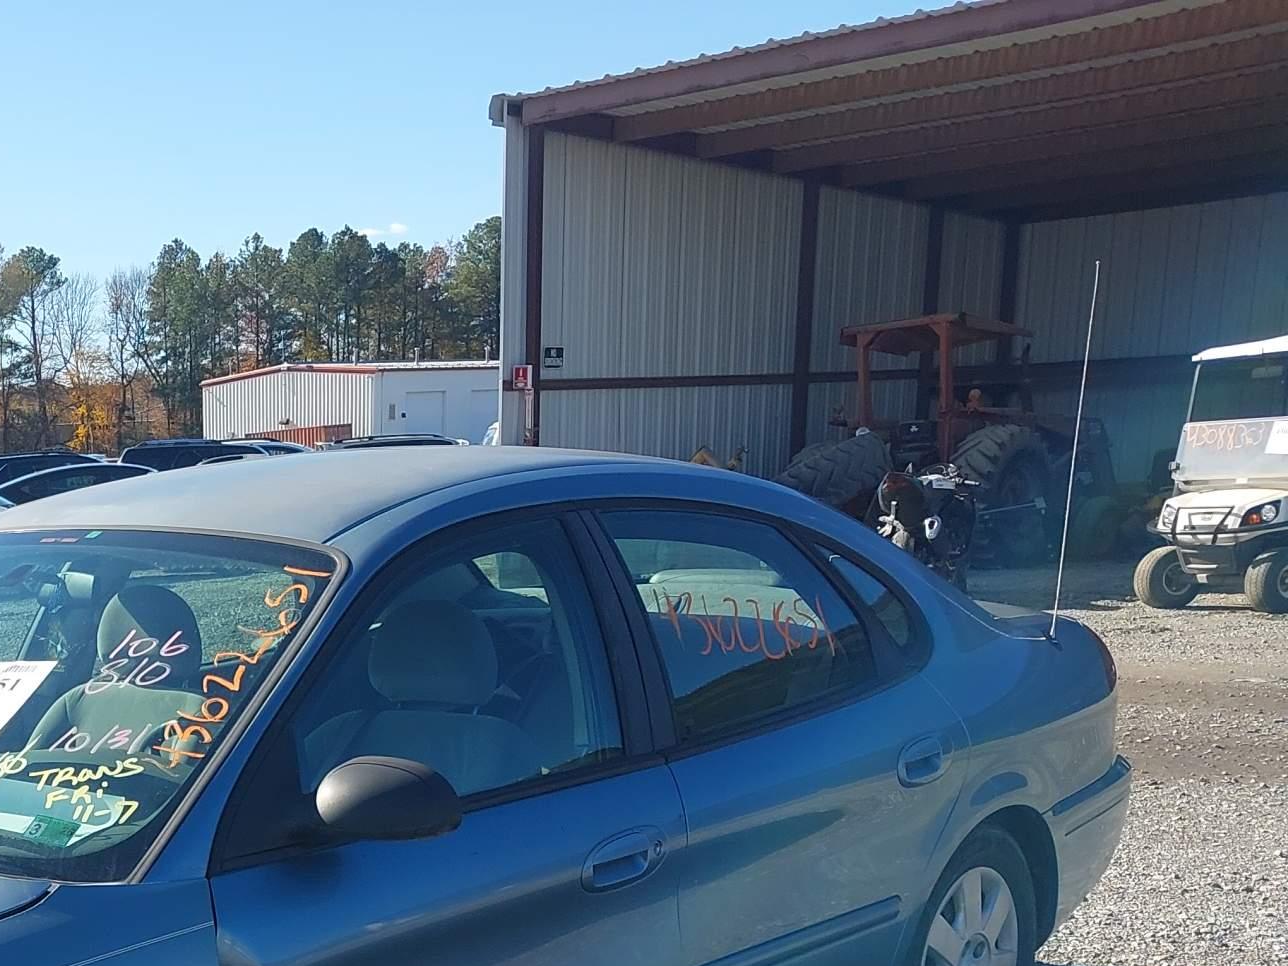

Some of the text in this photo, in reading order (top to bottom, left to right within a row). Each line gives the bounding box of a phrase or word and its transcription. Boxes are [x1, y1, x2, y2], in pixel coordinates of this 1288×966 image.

[108, 629, 190, 659] 106
[84, 657, 172, 695] 810
[48, 725, 153, 754] 10/31
[72, 800, 139, 824] 11-7
